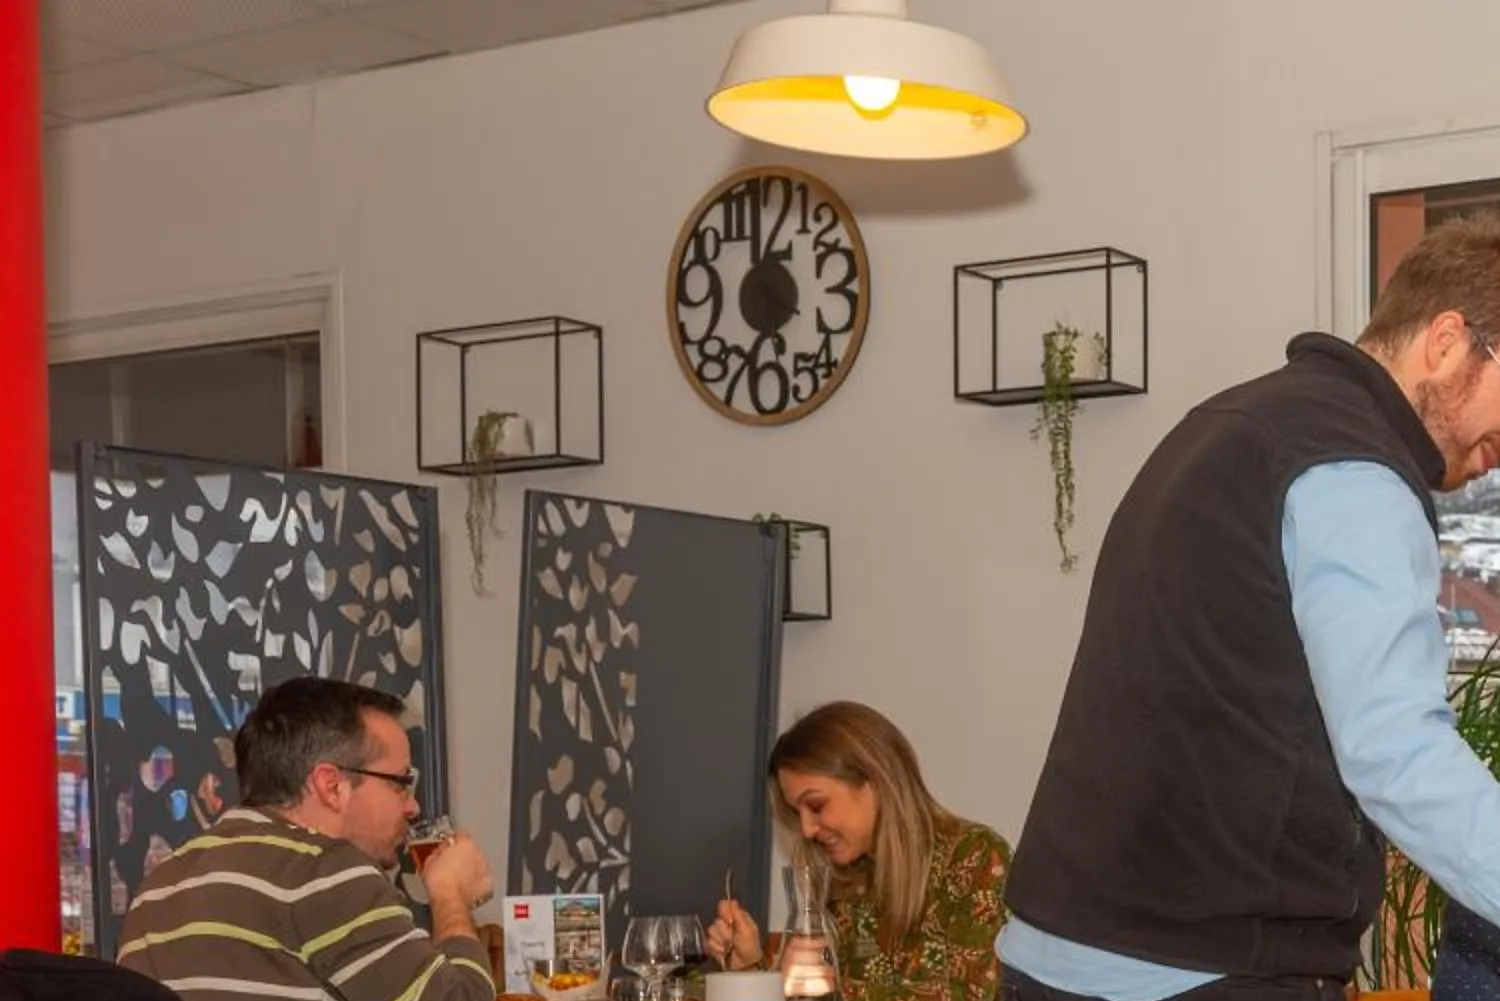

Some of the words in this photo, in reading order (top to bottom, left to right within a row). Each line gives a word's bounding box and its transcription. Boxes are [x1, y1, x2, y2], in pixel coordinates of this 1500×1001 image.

[795, 182, 812, 235] 1
[812, 202, 841, 252] 2
[676, 261, 723, 345] 9
[816, 247, 859, 334] 3
[697, 336, 729, 383] 8
[724, 344, 752, 408] 7
[747, 331, 790, 416] 6
[792, 352, 819, 403] 5
[812, 333, 839, 379] 4
